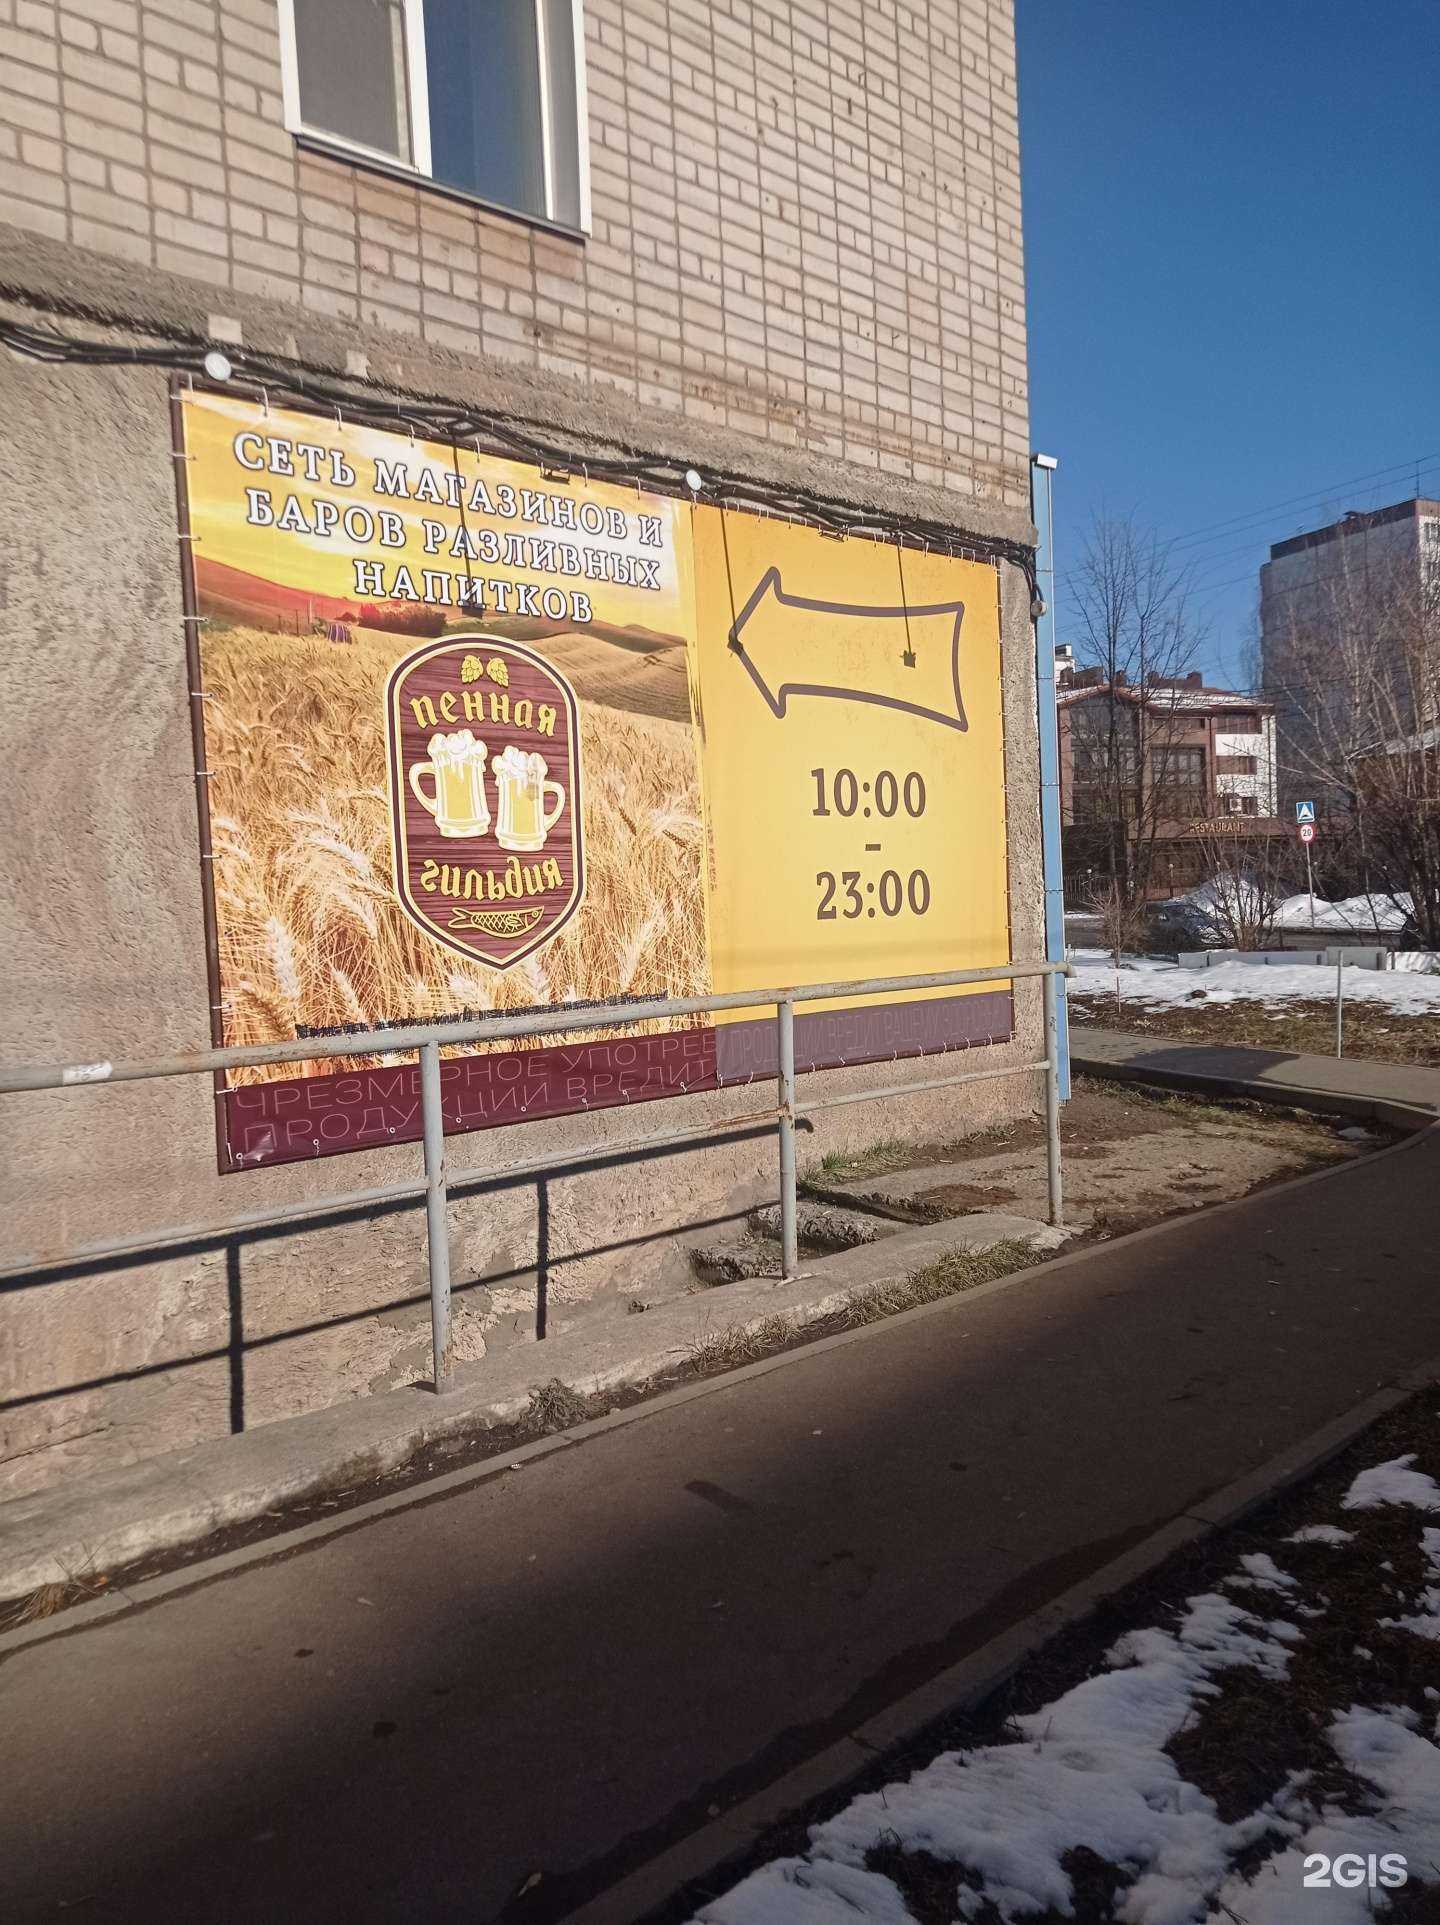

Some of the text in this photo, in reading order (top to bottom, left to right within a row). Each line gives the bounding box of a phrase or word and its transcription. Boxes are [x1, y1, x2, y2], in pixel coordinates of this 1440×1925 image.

[234, 433, 663, 547] СЕТЬ МАГАЗИНОВ И
[245, 488, 661, 590] БАРОВ РАЗЛИВНЫХ
[353, 559, 593, 623] НАПИТКОВ
[811, 768, 927, 818] 10:00
[816, 869, 931, 920] 23:00
[565, 1058, 713, 1100] ВРЕДИТ
